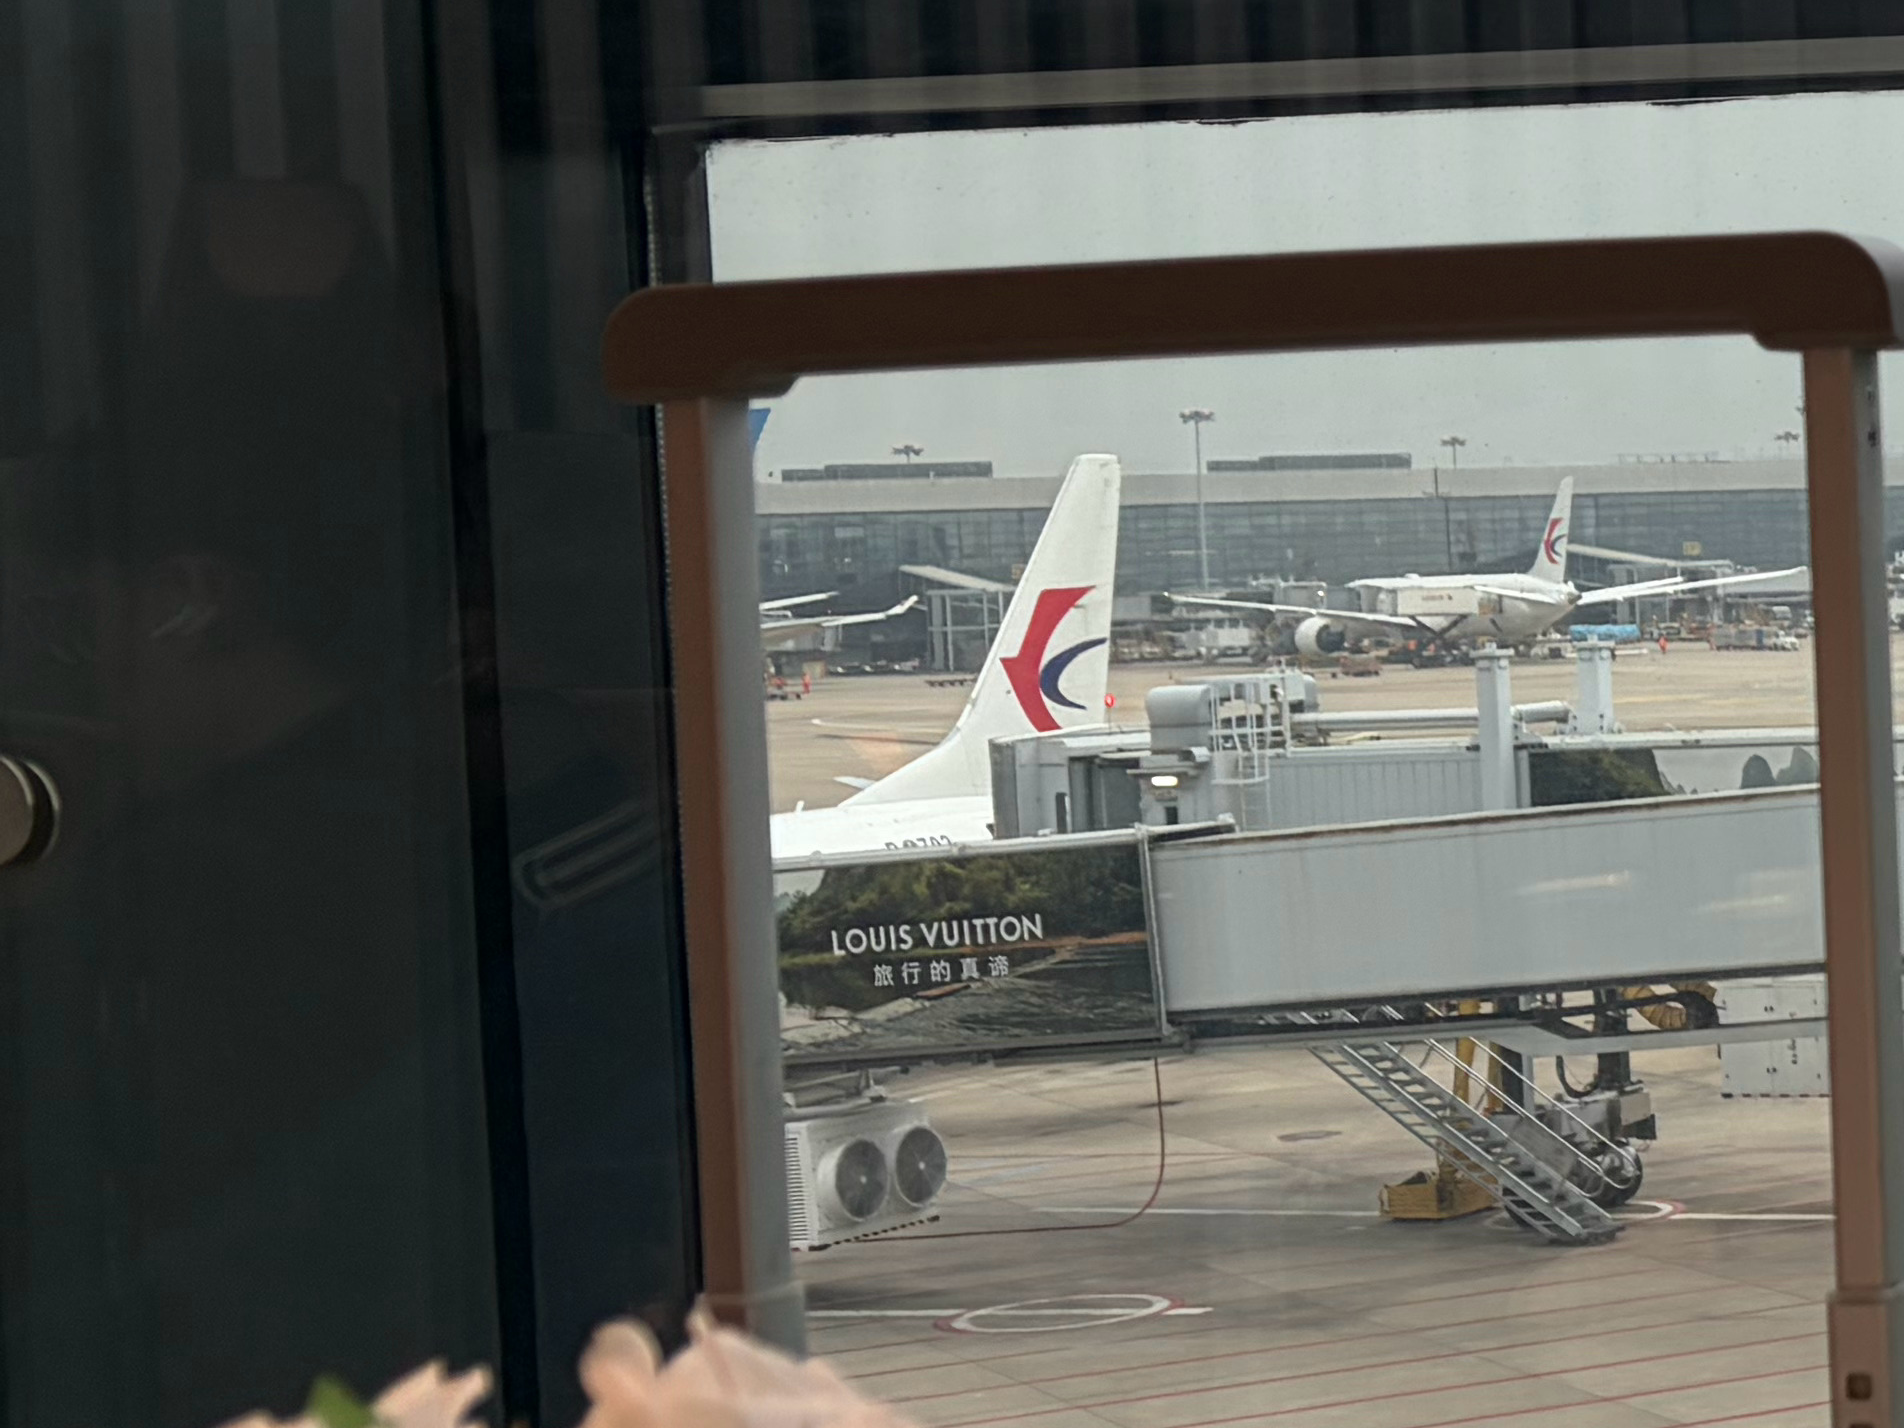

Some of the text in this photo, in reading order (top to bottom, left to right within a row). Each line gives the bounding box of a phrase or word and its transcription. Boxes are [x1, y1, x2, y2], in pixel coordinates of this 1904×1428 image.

[830, 912, 1044, 957] LOUIS VUITTON
[873, 954, 1010, 987] 旅行的真谛
